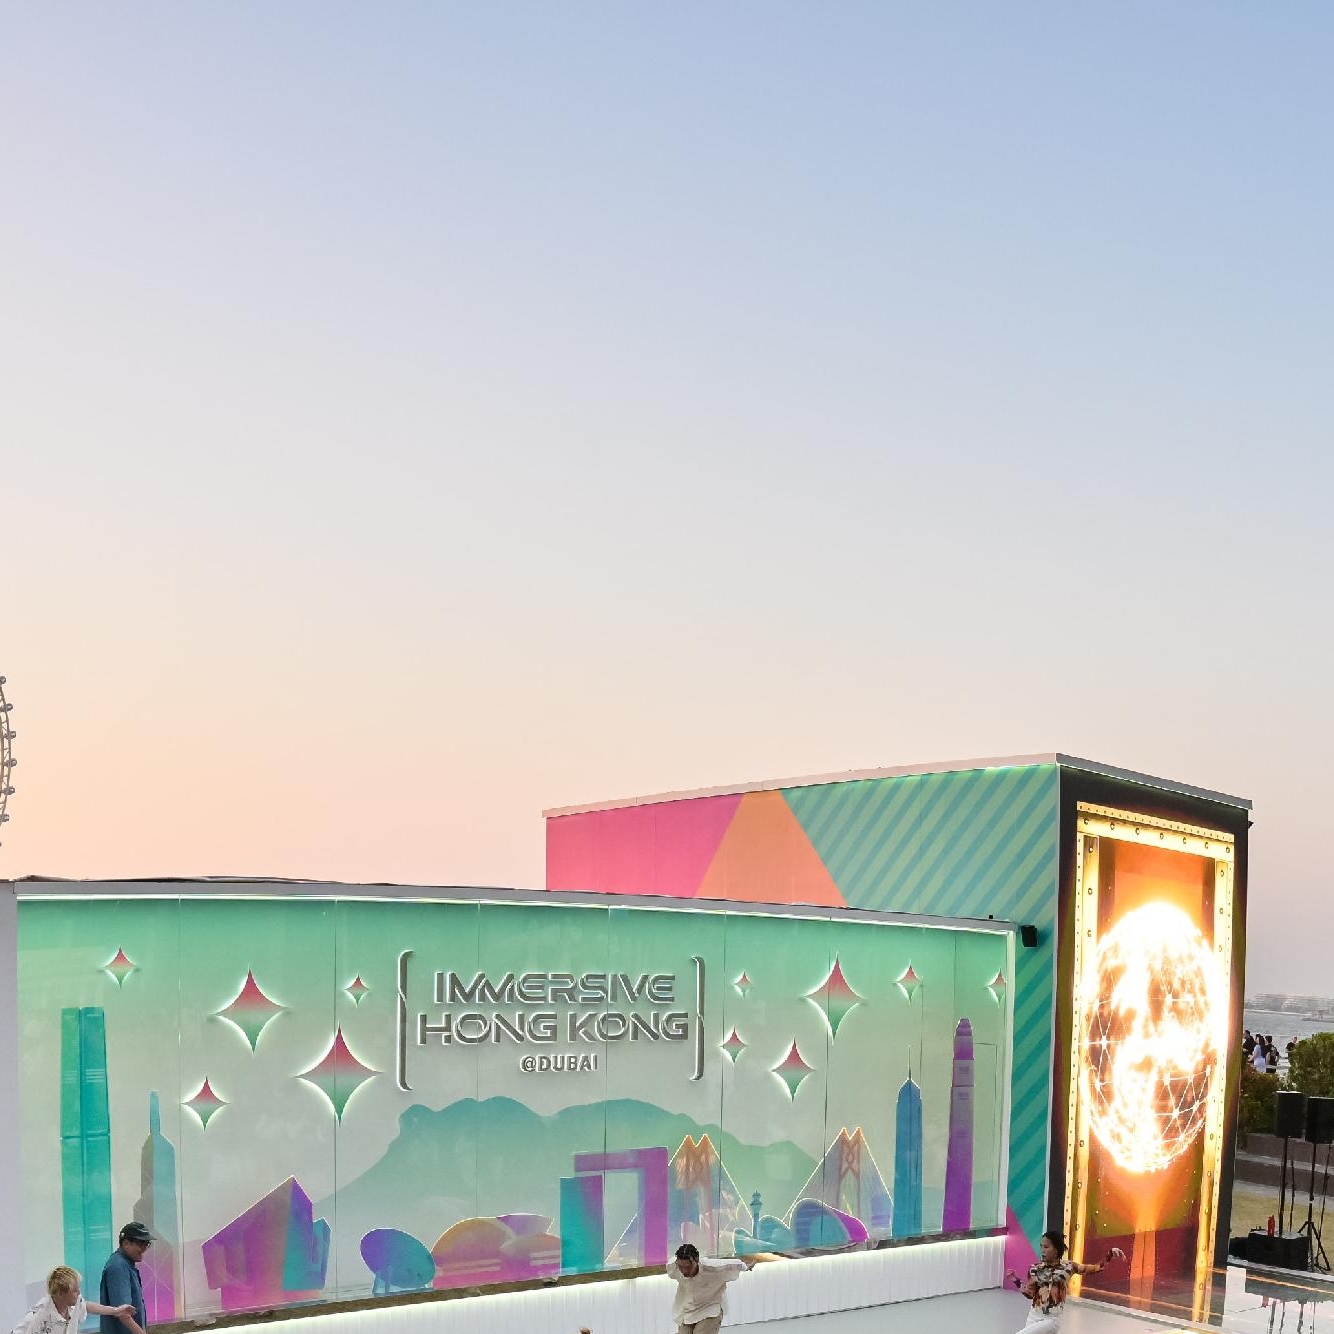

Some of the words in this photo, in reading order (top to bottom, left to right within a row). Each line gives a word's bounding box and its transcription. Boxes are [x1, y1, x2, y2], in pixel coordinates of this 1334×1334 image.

[434, 971, 676, 1004] IMMERSIVE
[417, 1011, 558, 1046] HONG
[567, 1011, 689, 1042] KONG
[519, 1053, 598, 1073] @DUBAI
